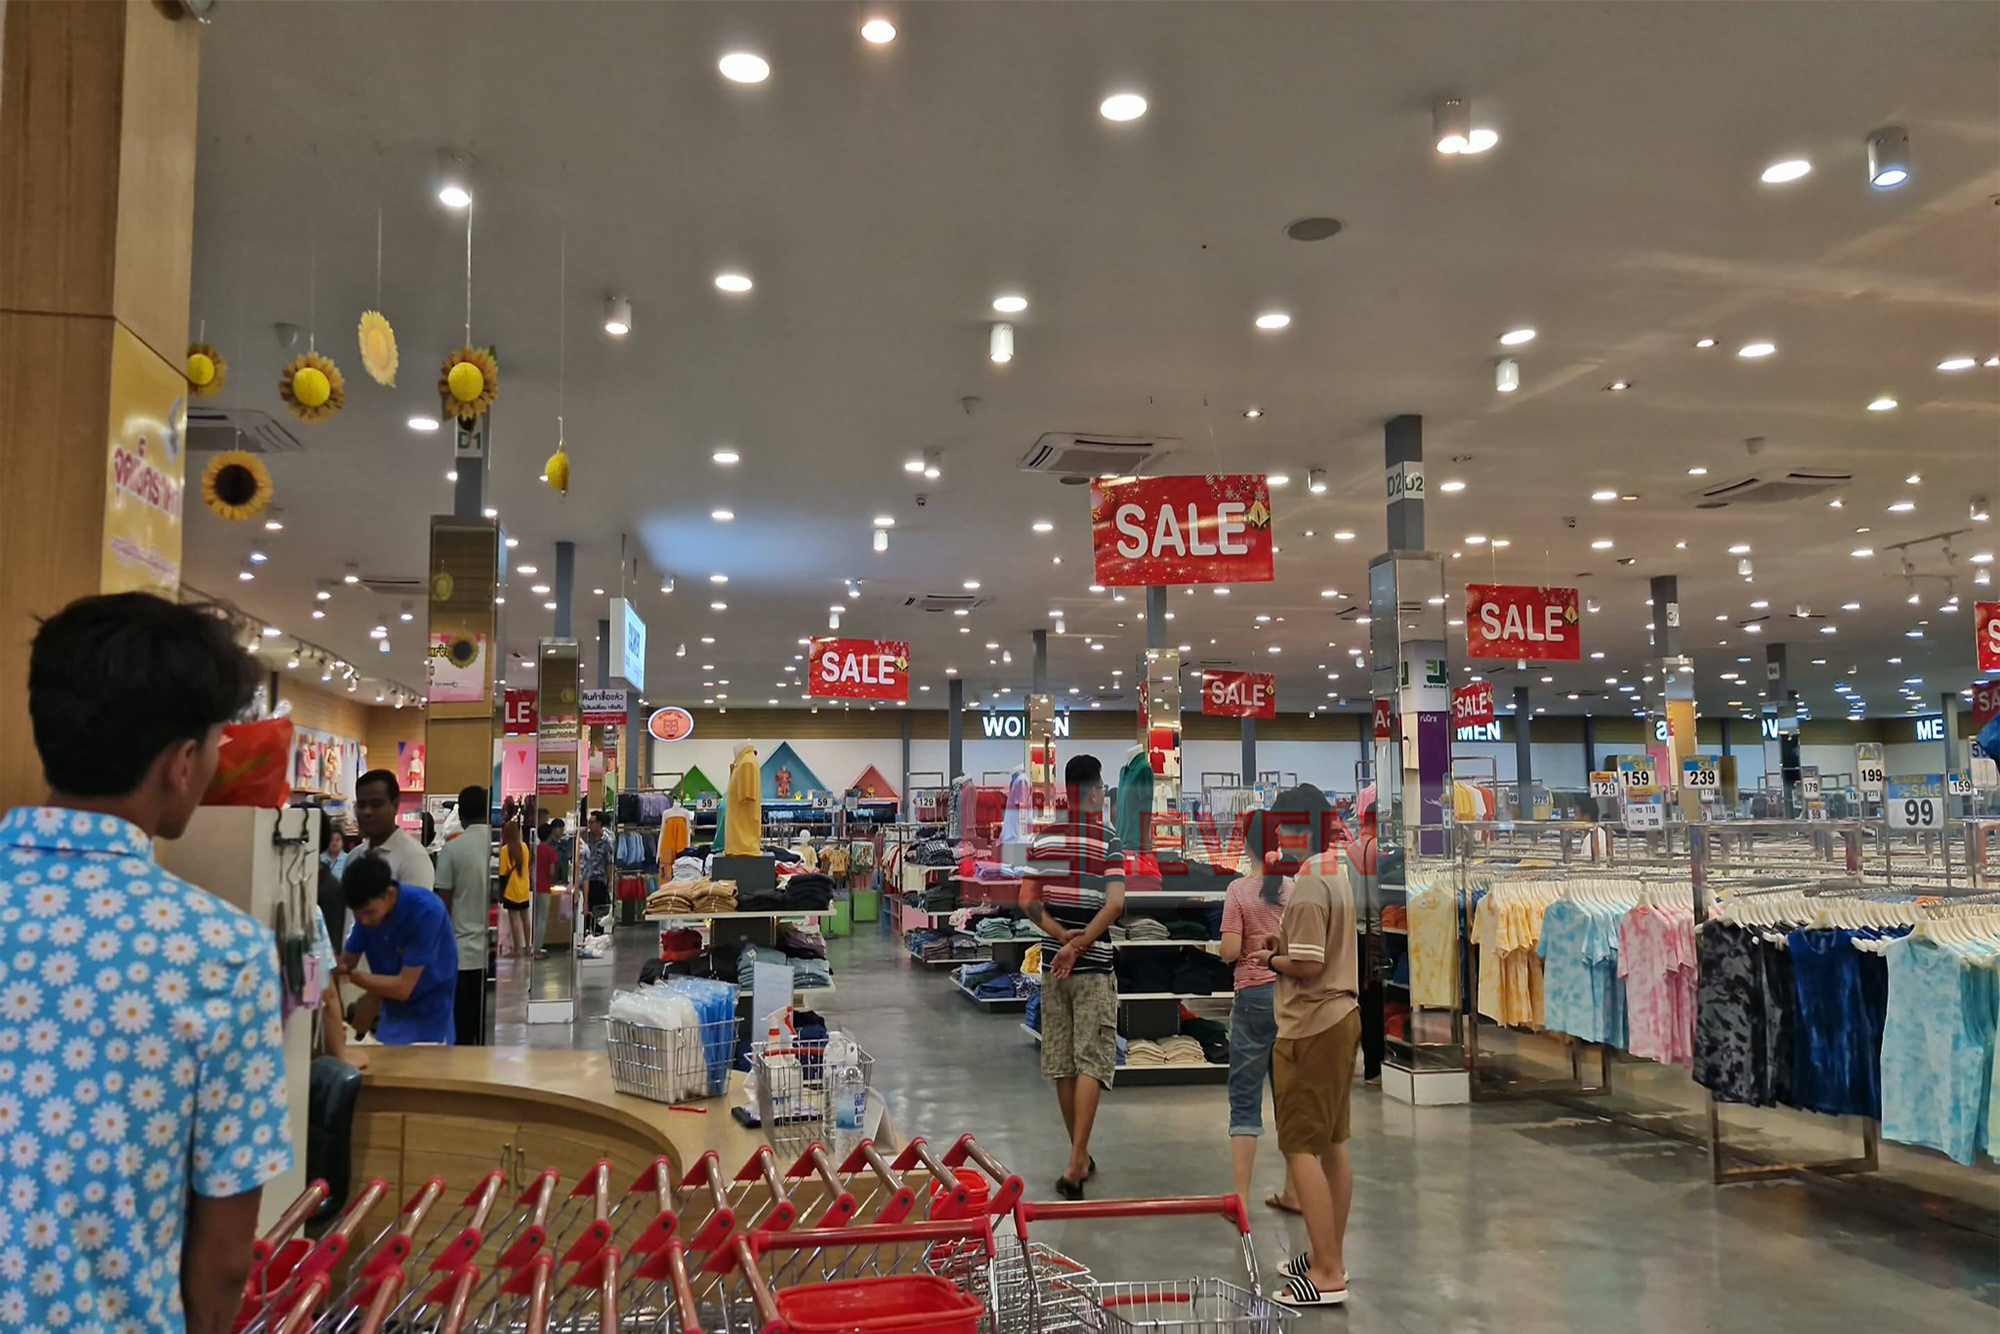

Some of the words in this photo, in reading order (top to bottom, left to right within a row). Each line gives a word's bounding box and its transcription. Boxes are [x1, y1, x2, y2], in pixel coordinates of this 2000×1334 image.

[458, 431, 481, 449] D1
[1387, 472, 1401, 497] D2
[1405, 475, 1423, 491] D2
[1115, 502, 1248, 558] SALE
[1480, 602, 1564, 642] SALE
[821, 651, 896, 685] SALE
[1211, 681, 1266, 706] SALE
[1456, 692, 1489, 719] SALE
[982, 716, 1069, 737] WON
[1457, 720, 1500, 740] MEN
[1623, 771, 1649, 786] 159
[1690, 771, 1715, 785] 239
[1861, 769, 1883, 782] 199
[1594, 783, 1615, 795] 129
[1804, 783, 1818, 793] 179
[1911, 784, 1941, 798] SALE
[1953, 782, 1971, 793] 159
[701, 799, 713, 808] 59
[816, 798, 829, 808] 59
[919, 796, 935, 807] 129
[1905, 799, 1934, 826] 99
